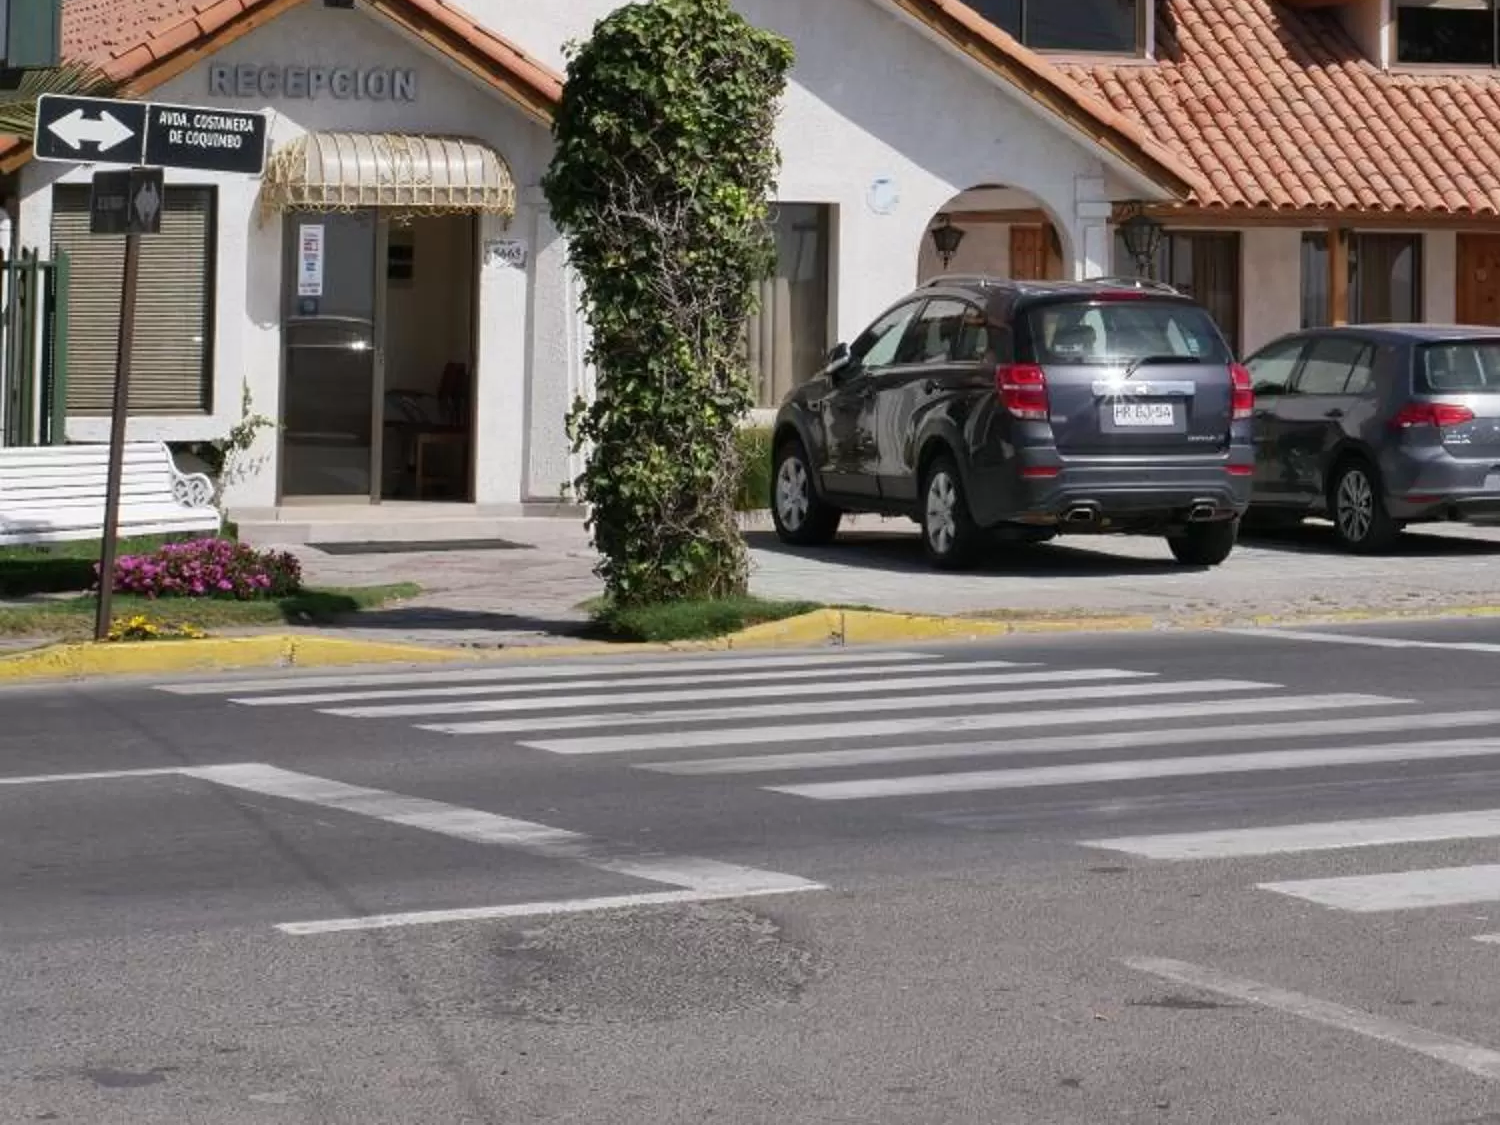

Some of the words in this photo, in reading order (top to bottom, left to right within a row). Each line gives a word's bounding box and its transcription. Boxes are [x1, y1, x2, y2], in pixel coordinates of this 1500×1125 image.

[208, 62, 418, 103] RECEPCION
[159, 111, 191, 127] AVDA.
[193, 114, 254, 132] COSTANERA
[169, 130, 183, 144] DE
[185, 131, 242, 149] COQUIMBO
